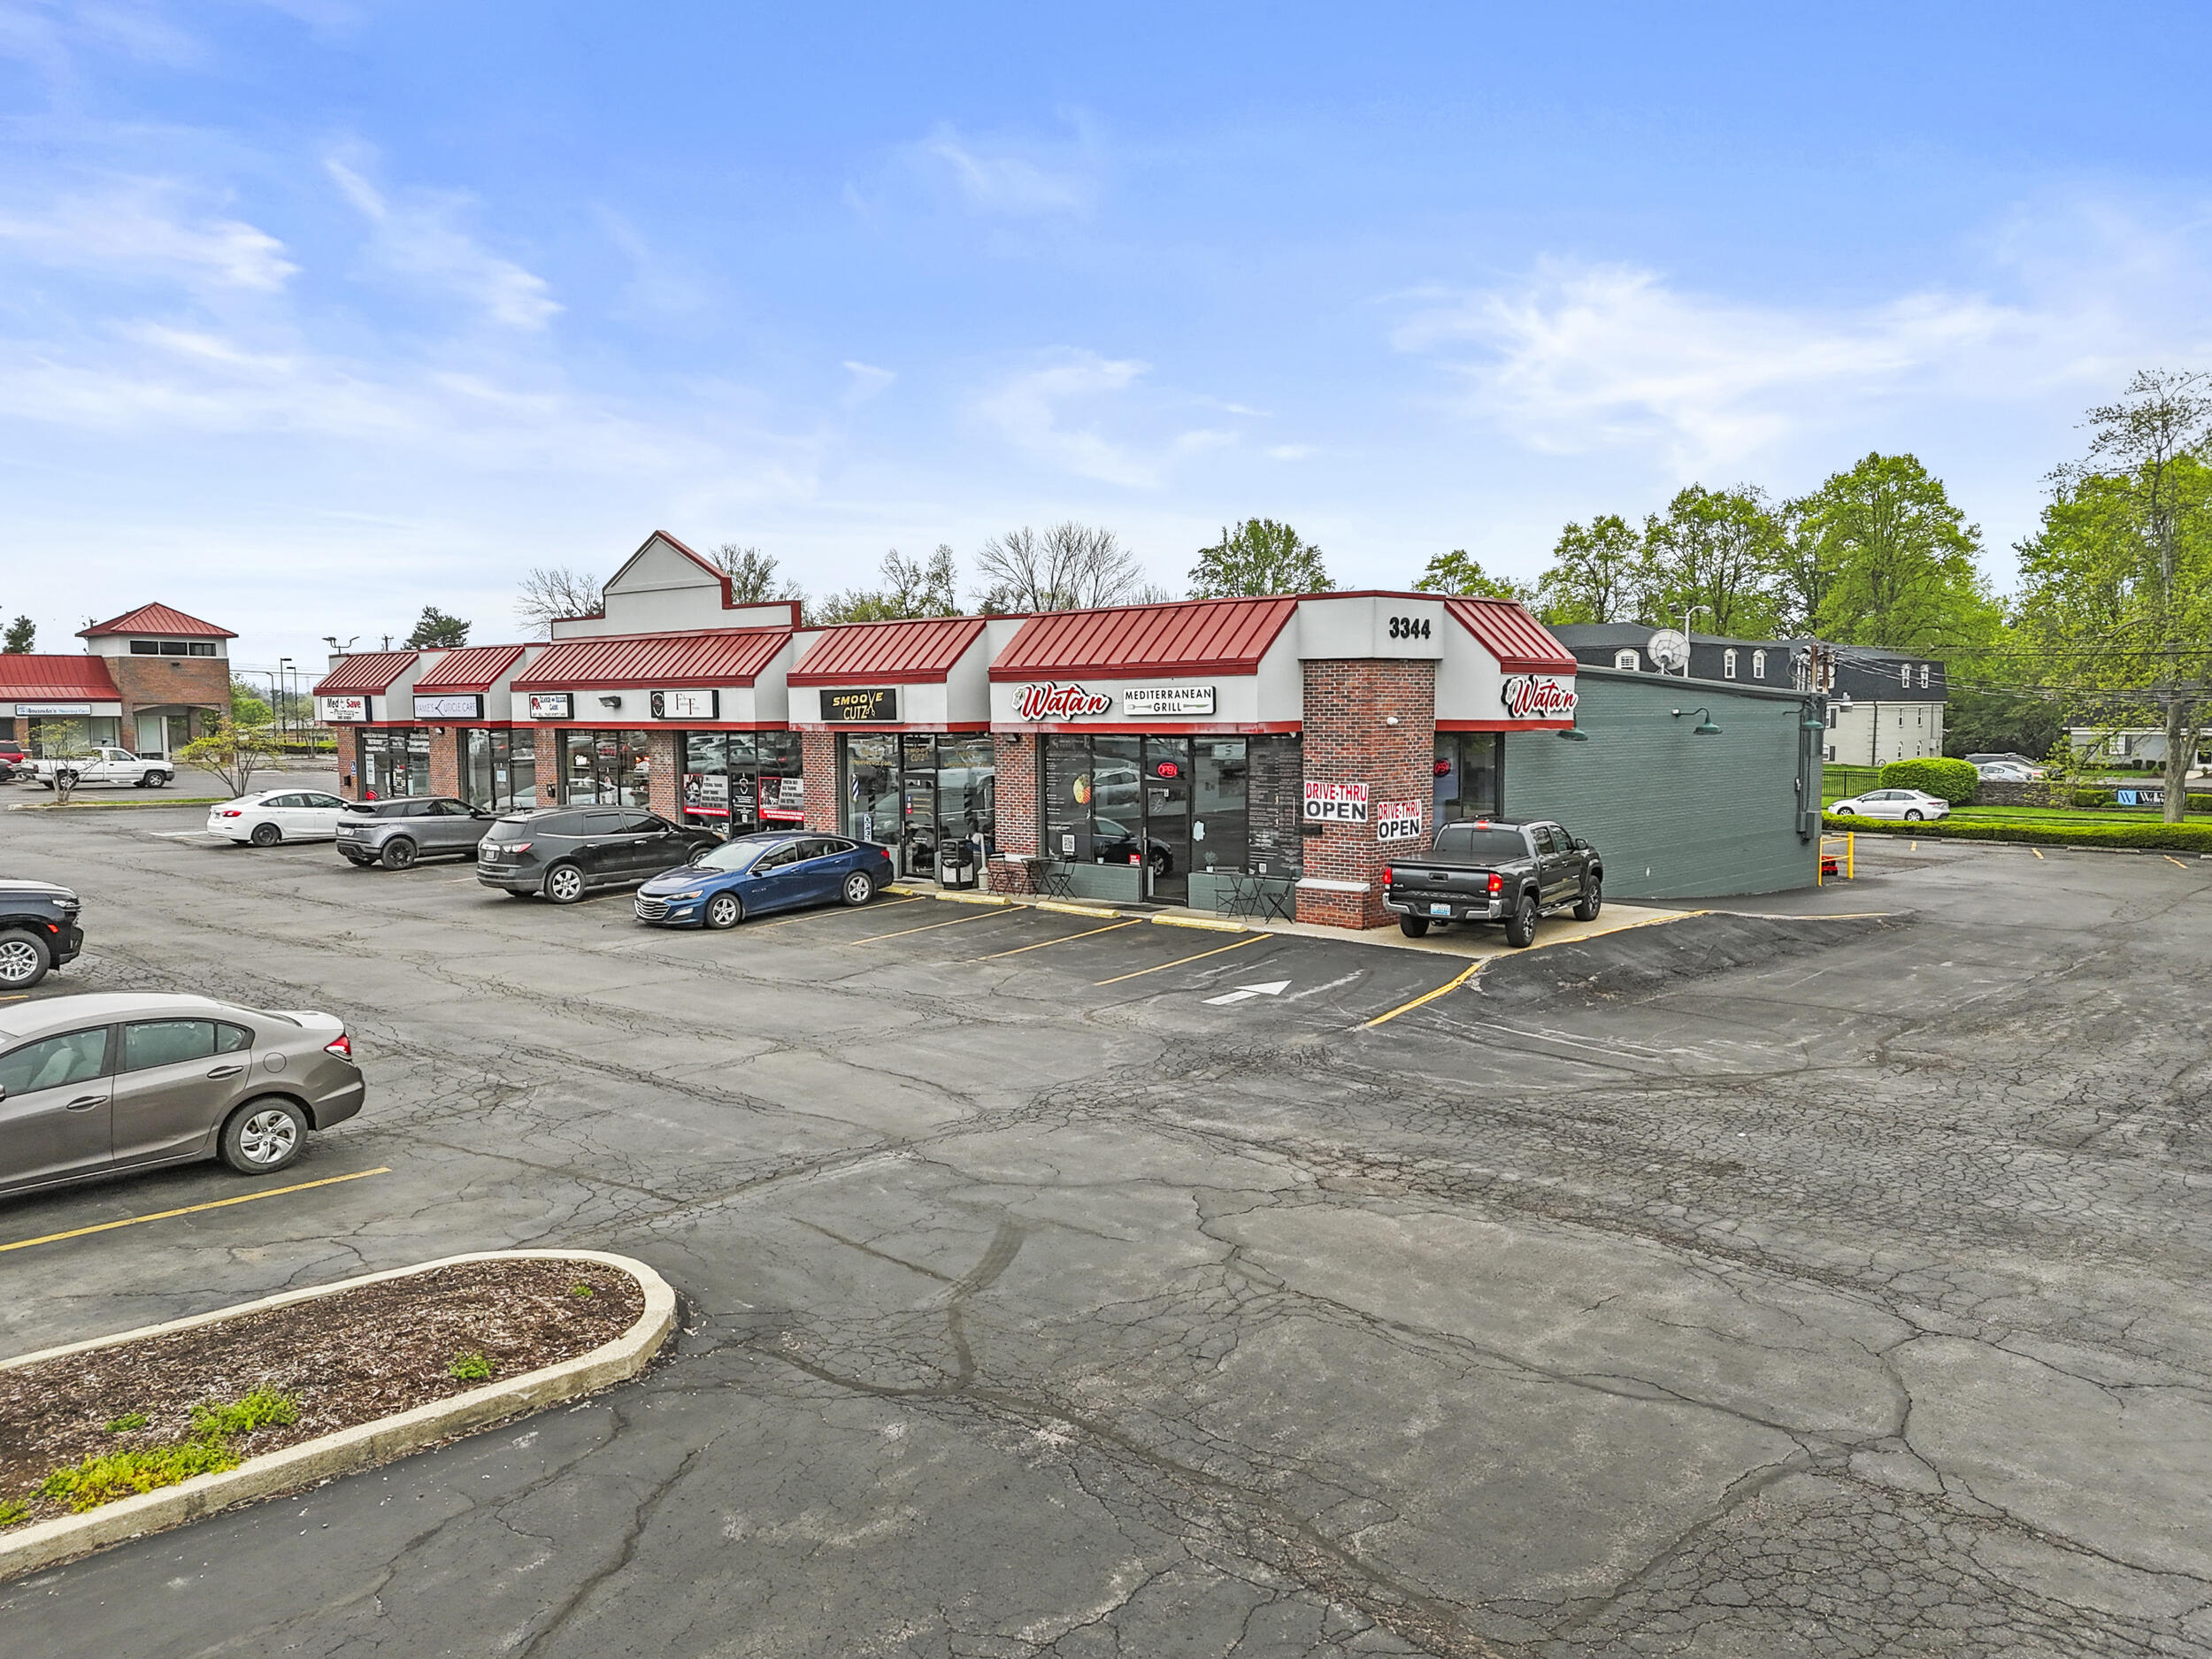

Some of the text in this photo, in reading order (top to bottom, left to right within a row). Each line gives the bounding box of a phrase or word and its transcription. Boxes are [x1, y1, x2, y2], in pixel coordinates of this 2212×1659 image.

[1389, 617, 1431, 639] 3344
[327, 697, 361, 708] Med Save
[1021, 683, 1108, 718] Watan
[1125, 688, 1212, 700] MEDITERRANEAN
[1514, 679, 1577, 714] Watan
[843, 705, 867, 719] CUTZ
[1153, 703, 1181, 712] GRILL
[1157, 764, 1178, 776] OPEN
[1306, 783, 1367, 802] DRIVE-THRU
[2120, 792, 2135, 803] W
[1306, 801, 1366, 820] OPEN
[1379, 802, 1419, 820] DRIVE-THRU
[1379, 818, 1419, 838] OPEN
